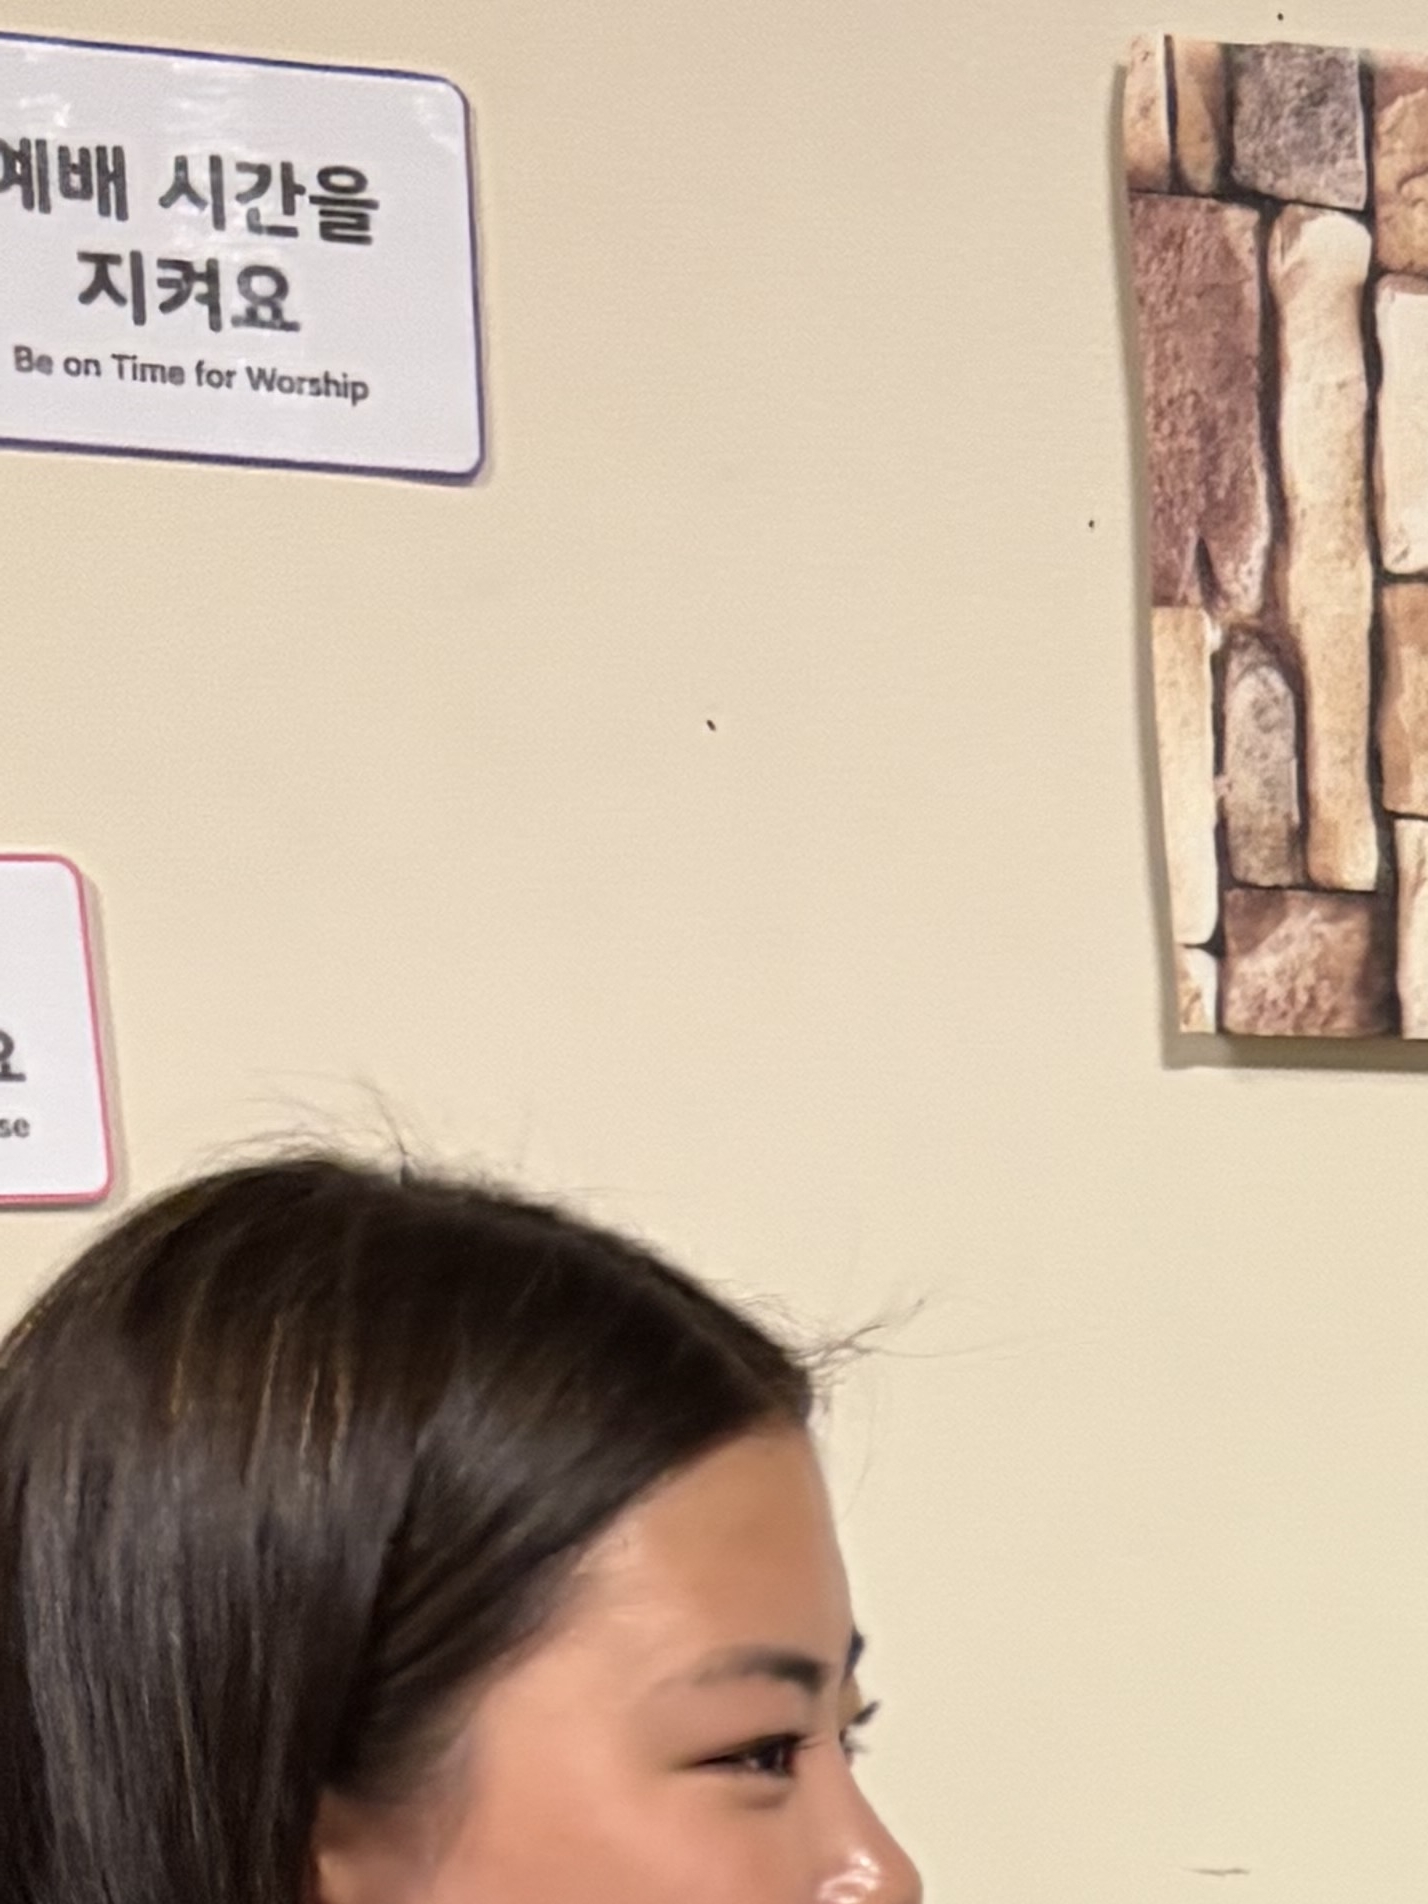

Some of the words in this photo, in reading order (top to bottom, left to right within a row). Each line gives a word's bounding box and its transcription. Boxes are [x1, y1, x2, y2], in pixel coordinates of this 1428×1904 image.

[0, 137, 129, 222] 예배
[158, 154, 380, 246] 시간을
[77, 249, 301, 332] 지켜요
[14, 345, 53, 375] Be
[63, 356, 102, 378] on
[112, 353, 185, 385] Time
[195, 360, 236, 389] for
[245, 366, 369, 406] Worship
